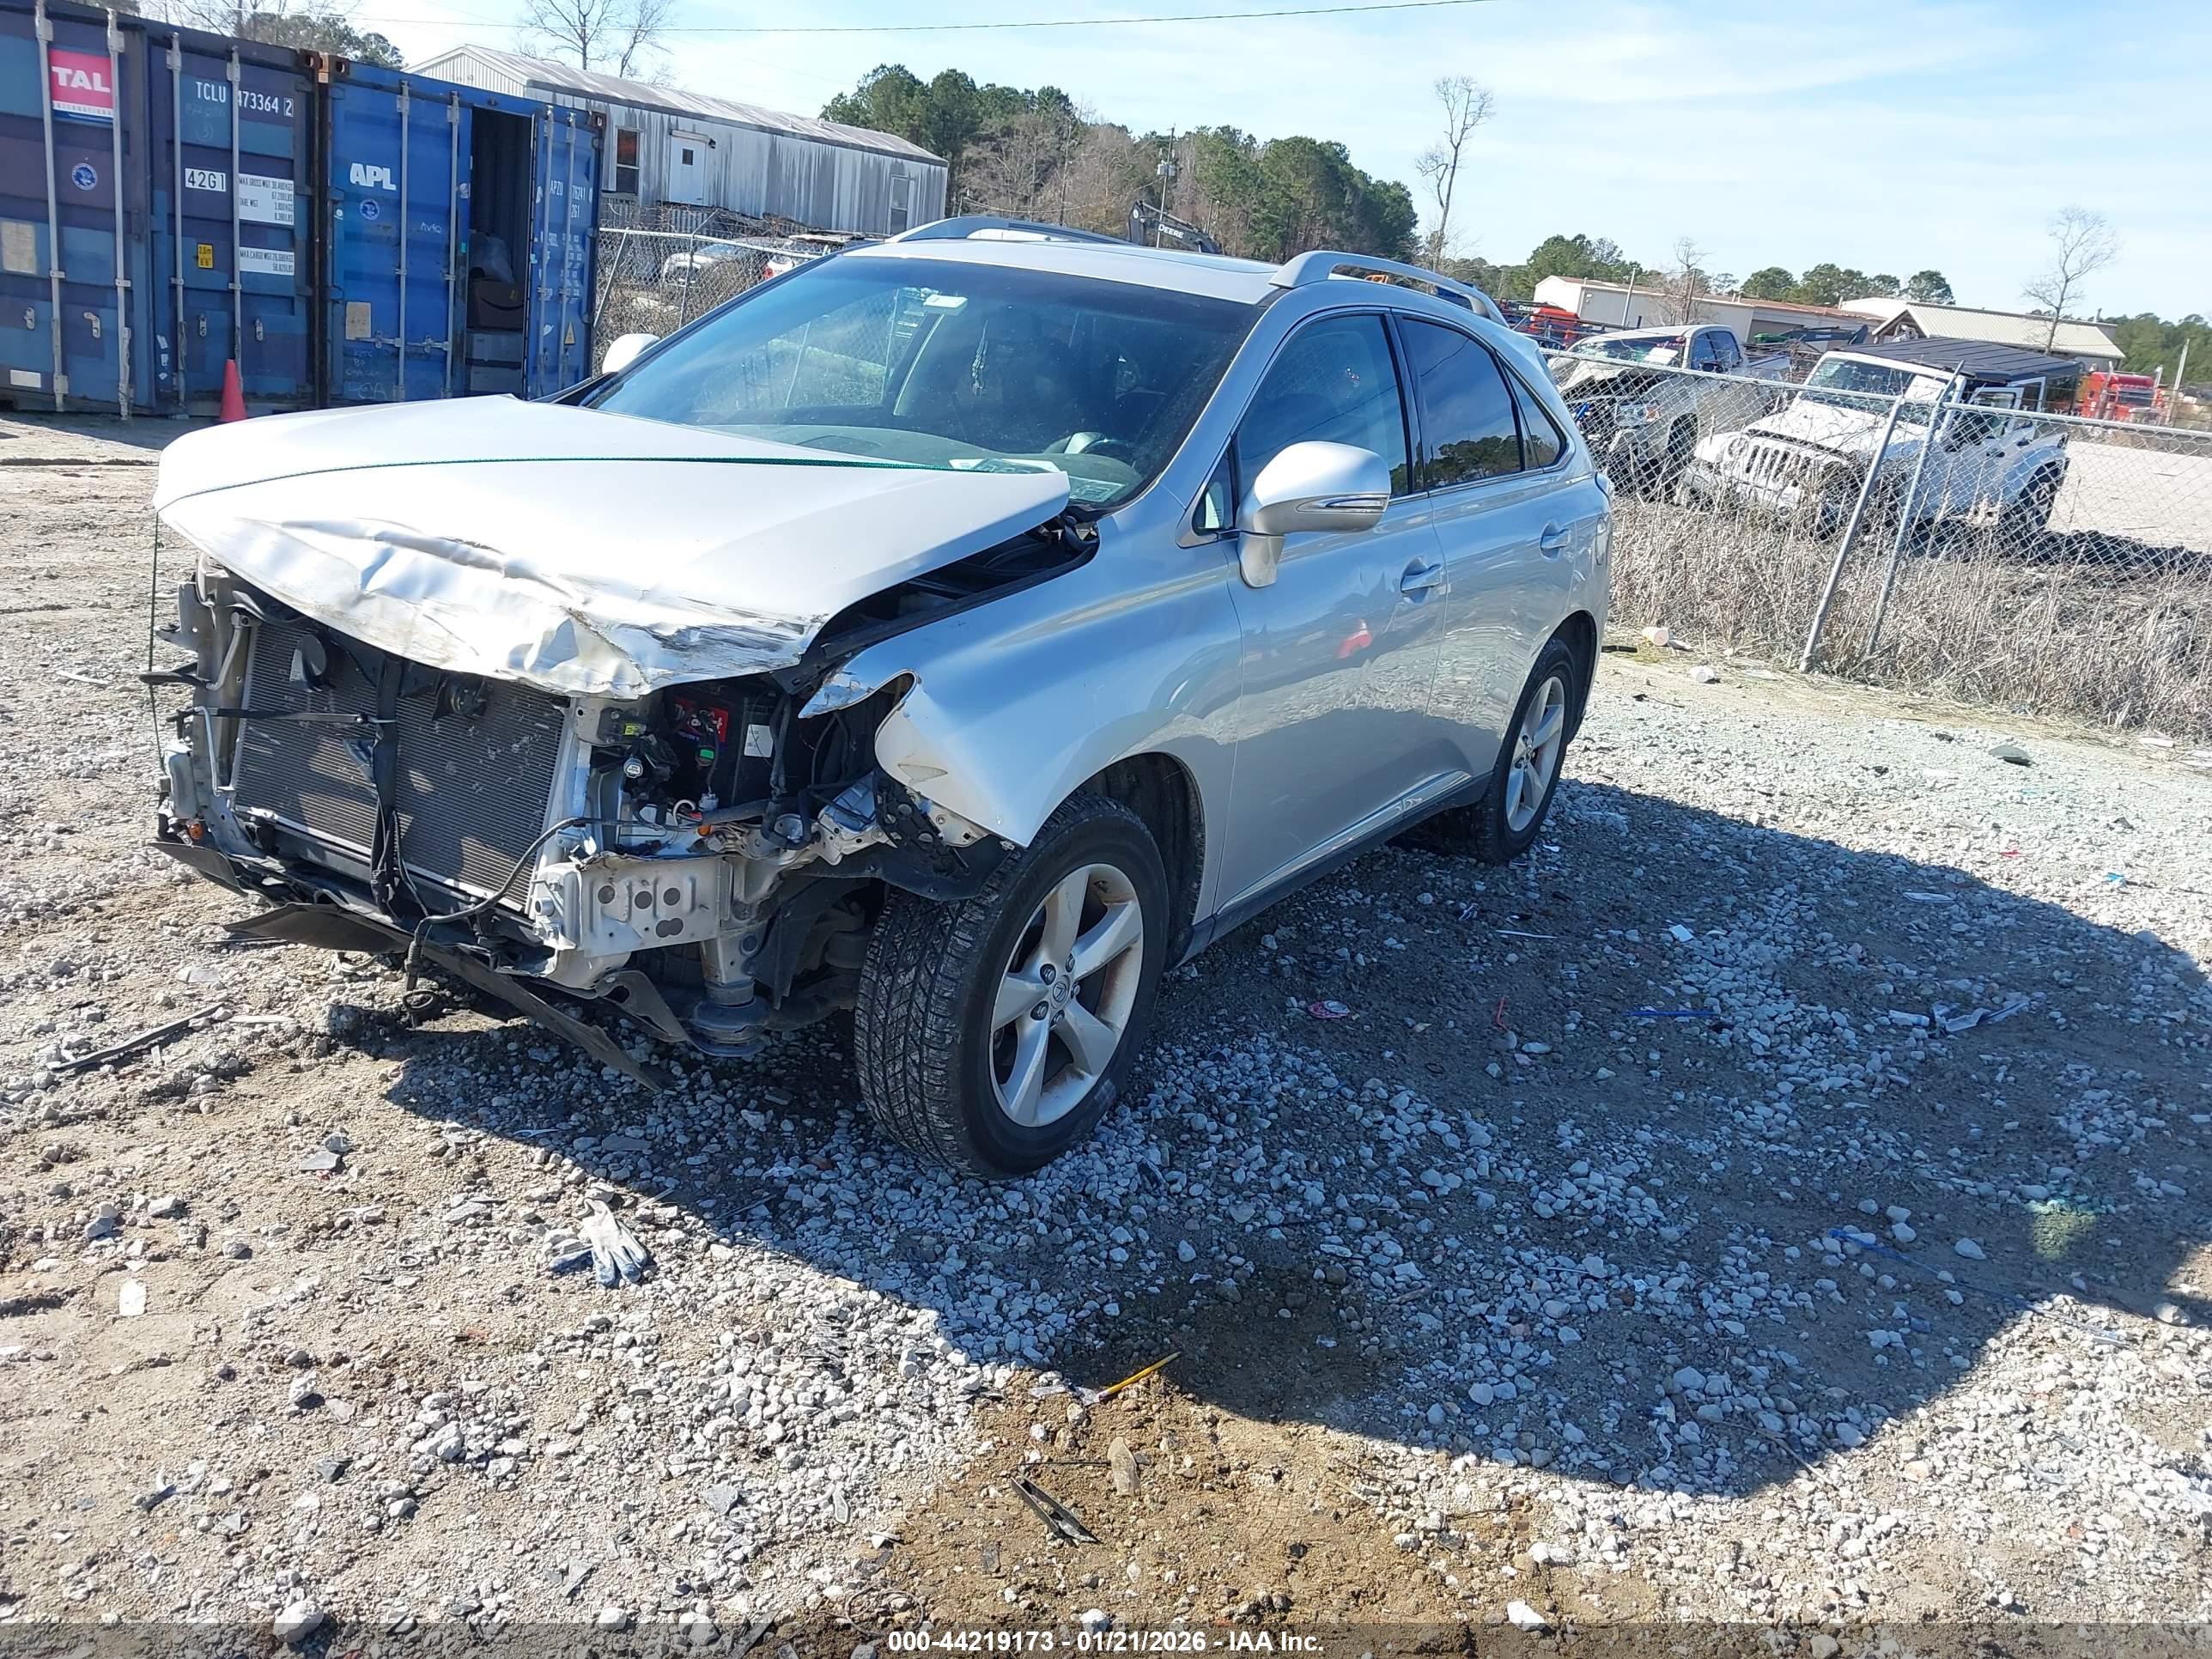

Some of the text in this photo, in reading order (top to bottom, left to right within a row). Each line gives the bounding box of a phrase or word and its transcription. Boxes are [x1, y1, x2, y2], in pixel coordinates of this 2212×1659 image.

[52, 65, 111, 93] TAL
[195, 82, 227, 103] TCLU
[284, 99, 293, 116] 2
[187, 170, 225, 191] 42G1
[349, 162, 397, 191] APL
[1158, 223, 1184, 239] DEERE
